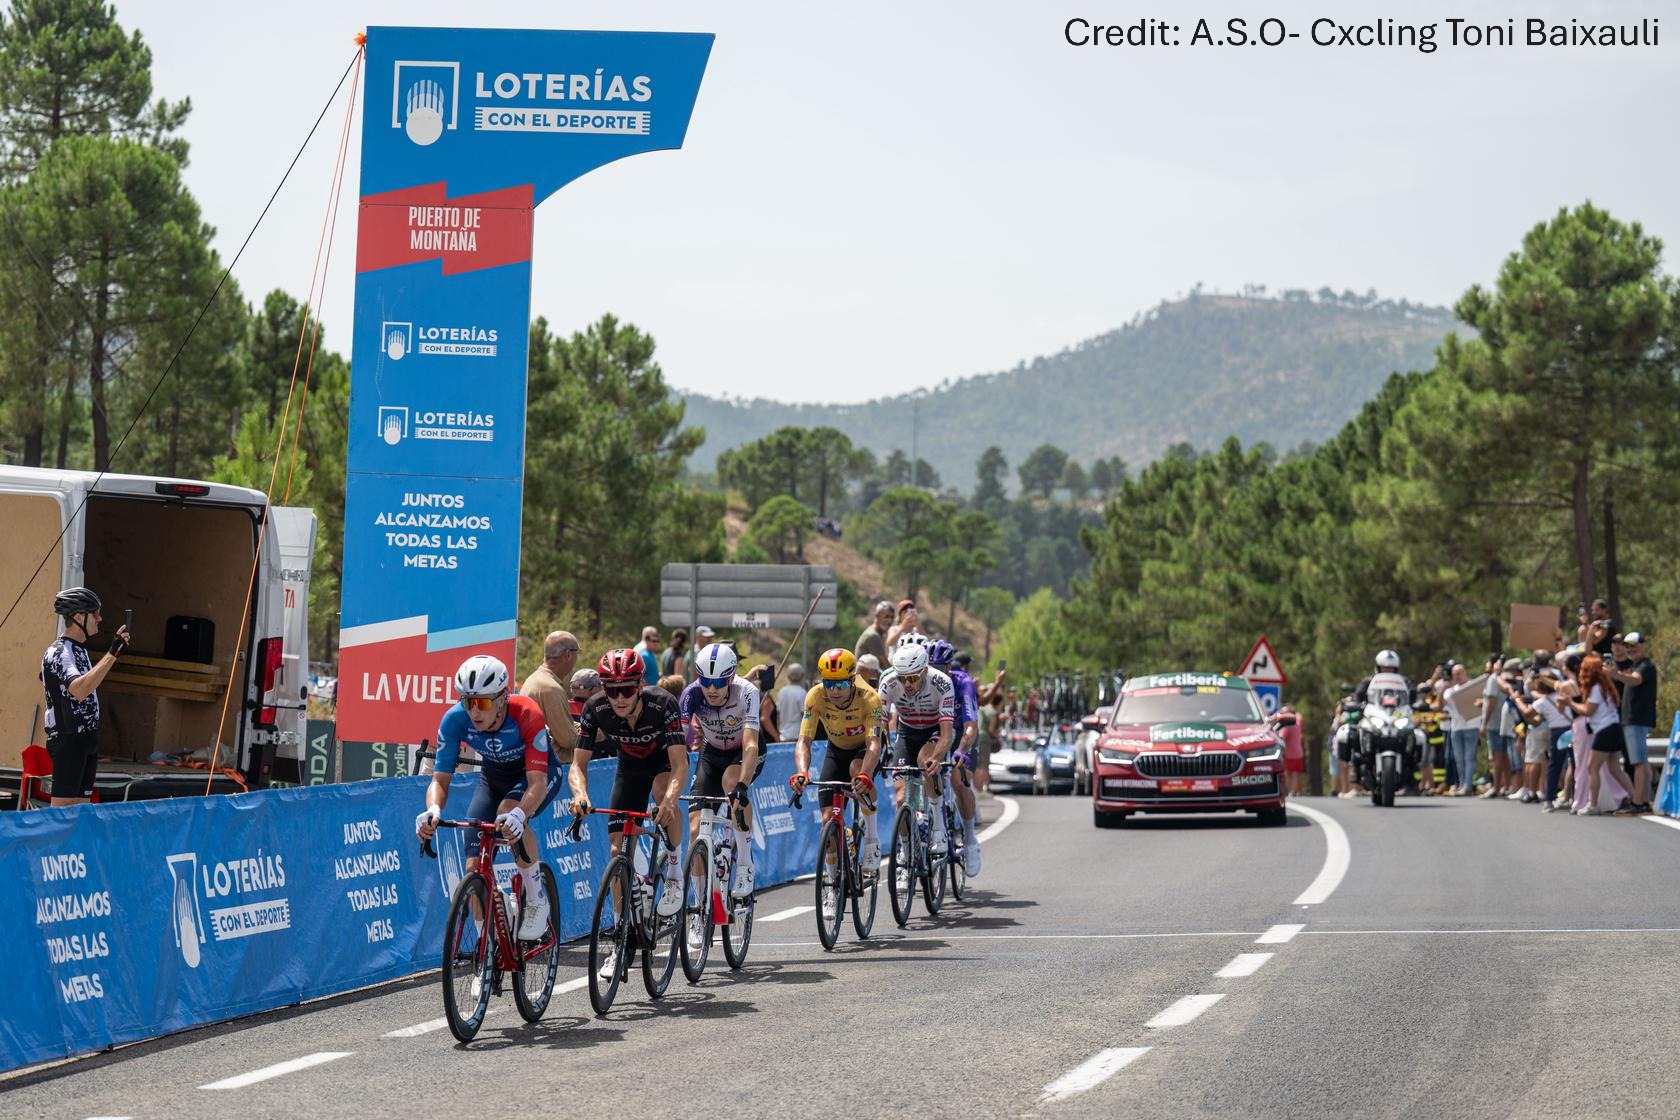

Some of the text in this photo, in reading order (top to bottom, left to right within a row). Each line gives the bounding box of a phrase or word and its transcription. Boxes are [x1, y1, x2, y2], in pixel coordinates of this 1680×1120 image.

[475, 68, 652, 102] LOTERÍAS
[488, 112, 636, 129] CON EL DEPORTE
[408, 207, 481, 228] PUERTO DE
[410, 225, 477, 251] MONTAÑA
[419, 326, 498, 342] LOTERÍAS
[455, 346, 491, 354] DEPORTE
[415, 411, 494, 427] LOTERÍAS
[451, 431, 487, 439] DEPORTE
[402, 493, 464, 508] JUNTOS
[375, 512, 490, 530] ALCANZAMOS
[386, 532, 477, 550] TODAS LAS
[404, 554, 458, 569] METAS
[363, 672, 458, 704] LA VUEL
[344, 820, 381, 845] JUNTOS
[41, 853, 87, 882] JUNTOS
[202, 848, 286, 898] LOTERÍAS
[334, 850, 400, 881] ALCANZAMOS
[36, 891, 111, 925] ALCANZAMOS
[347, 883, 398, 912] TODAS LAS
[220, 905, 285, 931] CON EL DEPORTE
[365, 918, 393, 944] METAS
[48, 932, 109, 965] TODAS LAS
[61, 974, 104, 1004] METAS
